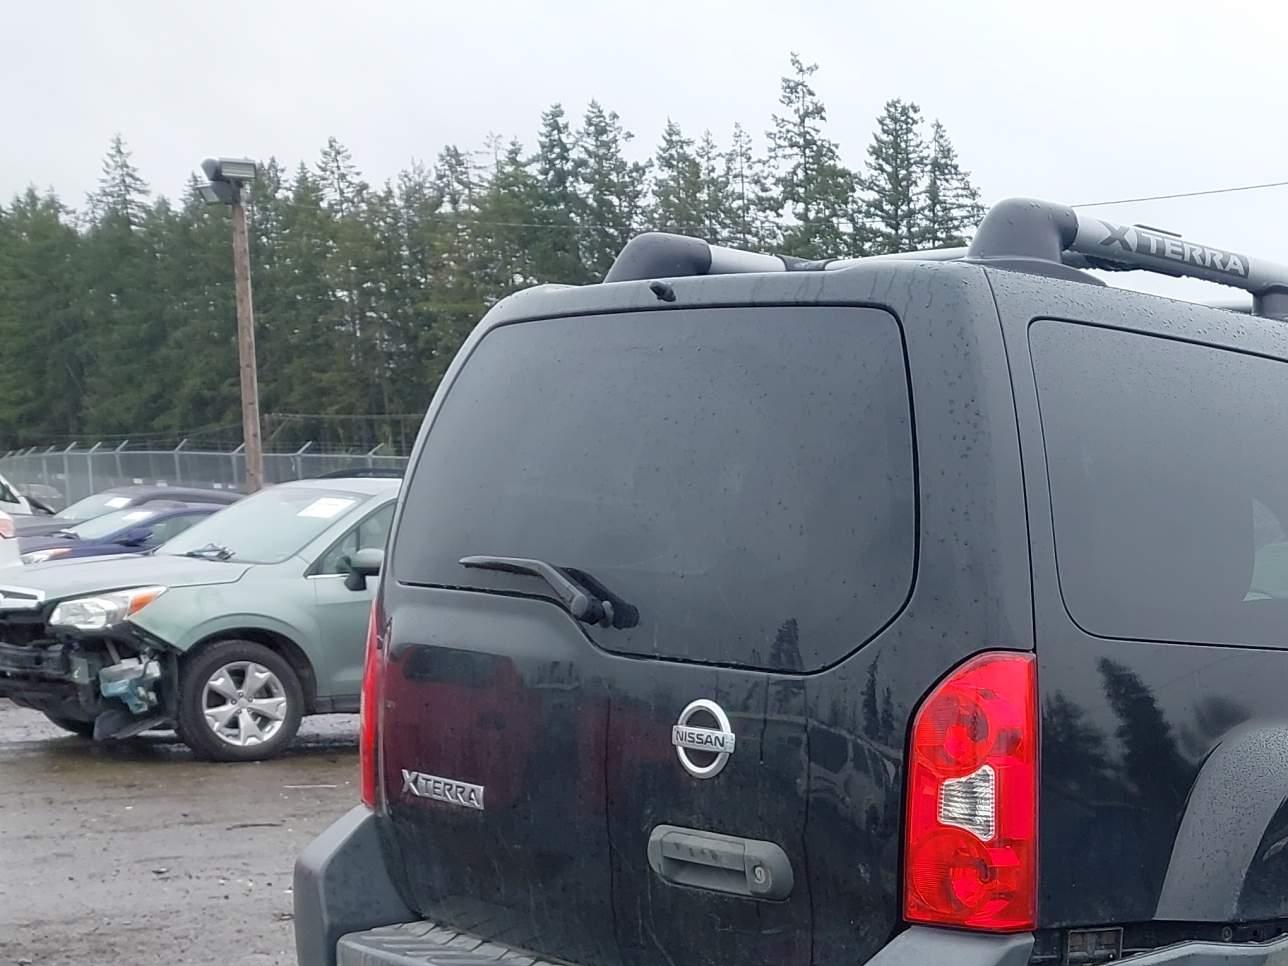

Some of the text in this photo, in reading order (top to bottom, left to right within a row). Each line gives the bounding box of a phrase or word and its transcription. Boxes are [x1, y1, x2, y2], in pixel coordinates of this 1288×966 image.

[1097, 219, 1246, 277] XTERRA
[675, 729, 726, 748] NISSAN
[401, 769, 484, 810] XTERRA
